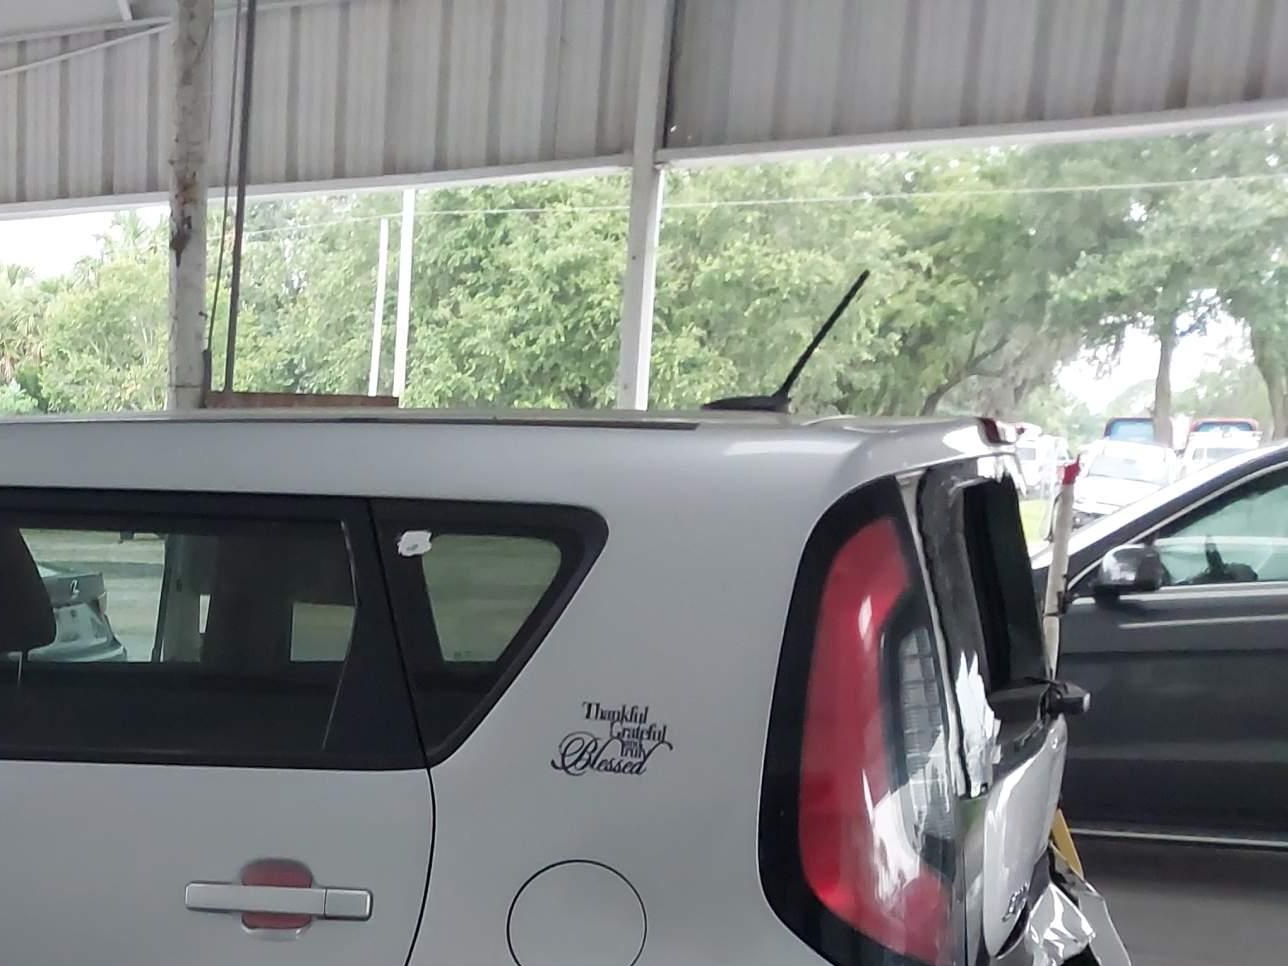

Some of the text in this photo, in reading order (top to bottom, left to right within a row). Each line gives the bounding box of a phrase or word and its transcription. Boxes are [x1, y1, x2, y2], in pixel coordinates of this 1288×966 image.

[582, 702, 649, 725] Thankful
[610, 720, 667, 743] Grateful
[551, 731, 673, 776] Blessed
